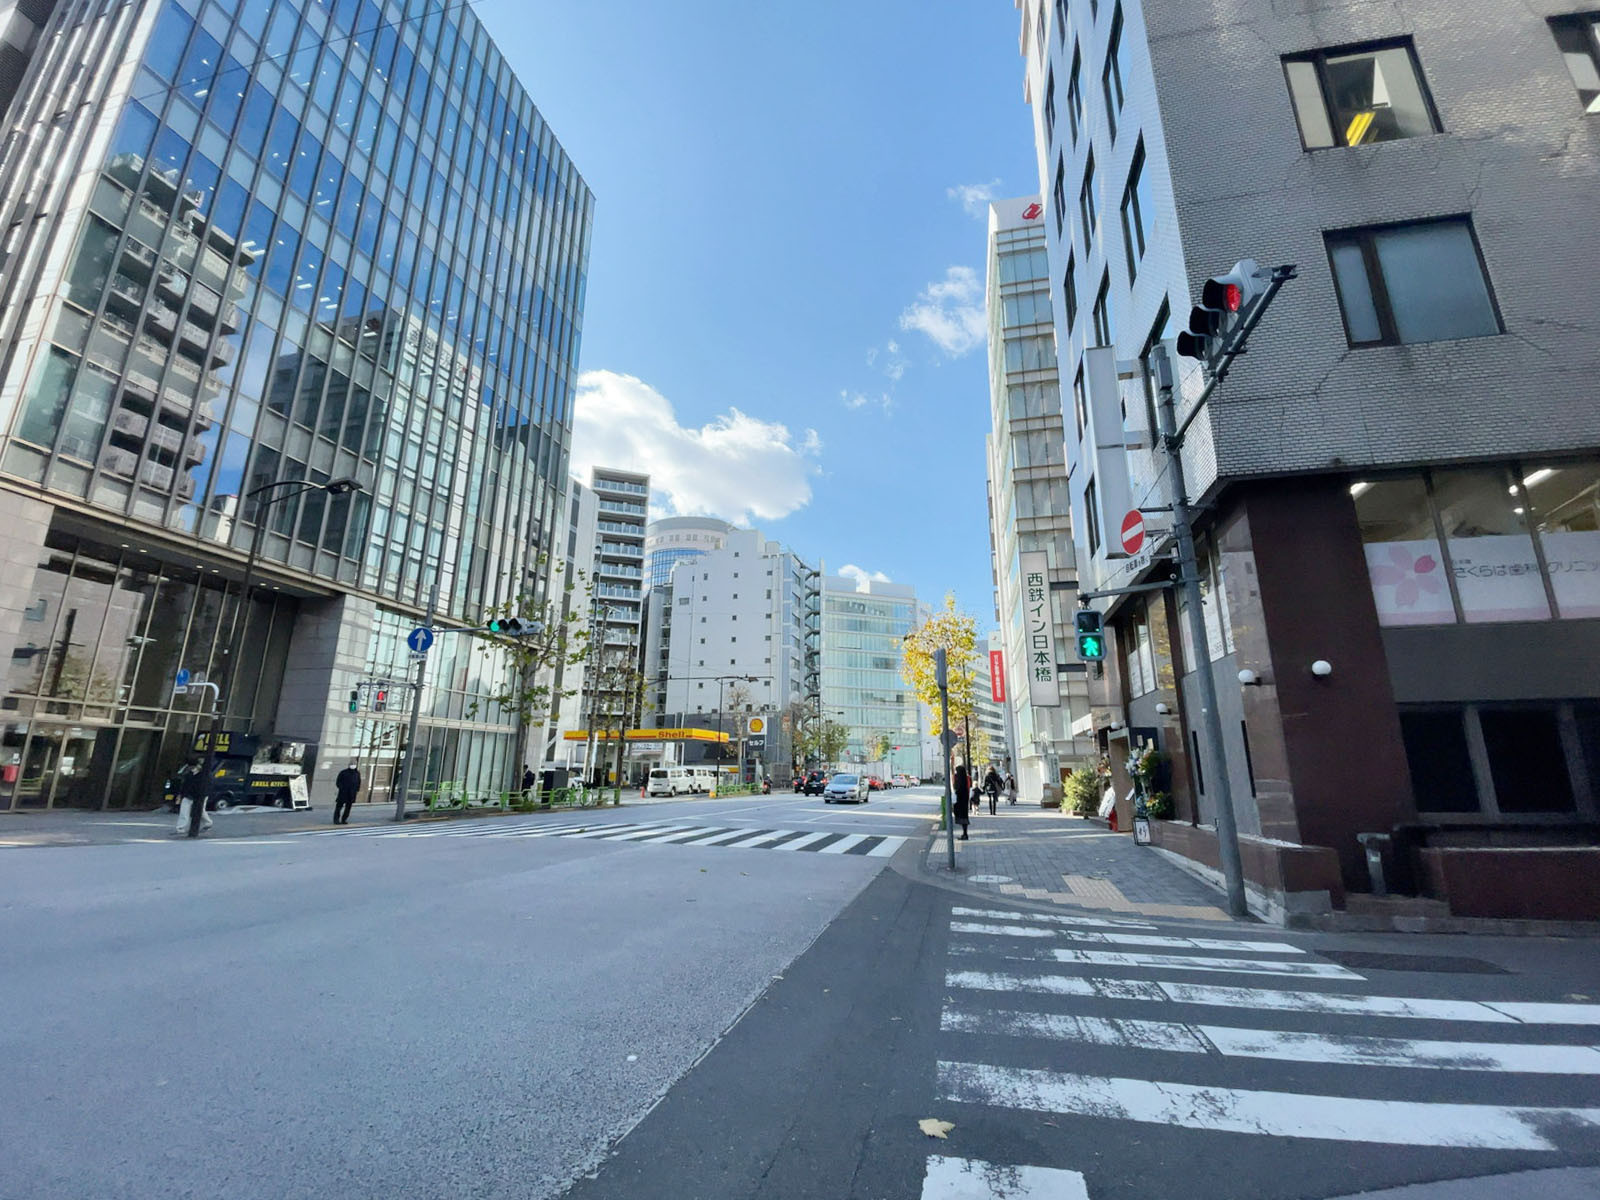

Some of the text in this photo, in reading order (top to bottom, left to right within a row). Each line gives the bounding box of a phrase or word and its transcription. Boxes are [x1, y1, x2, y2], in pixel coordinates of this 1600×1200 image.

[1027, 572, 1052, 682] 西鉄イン日本橋
